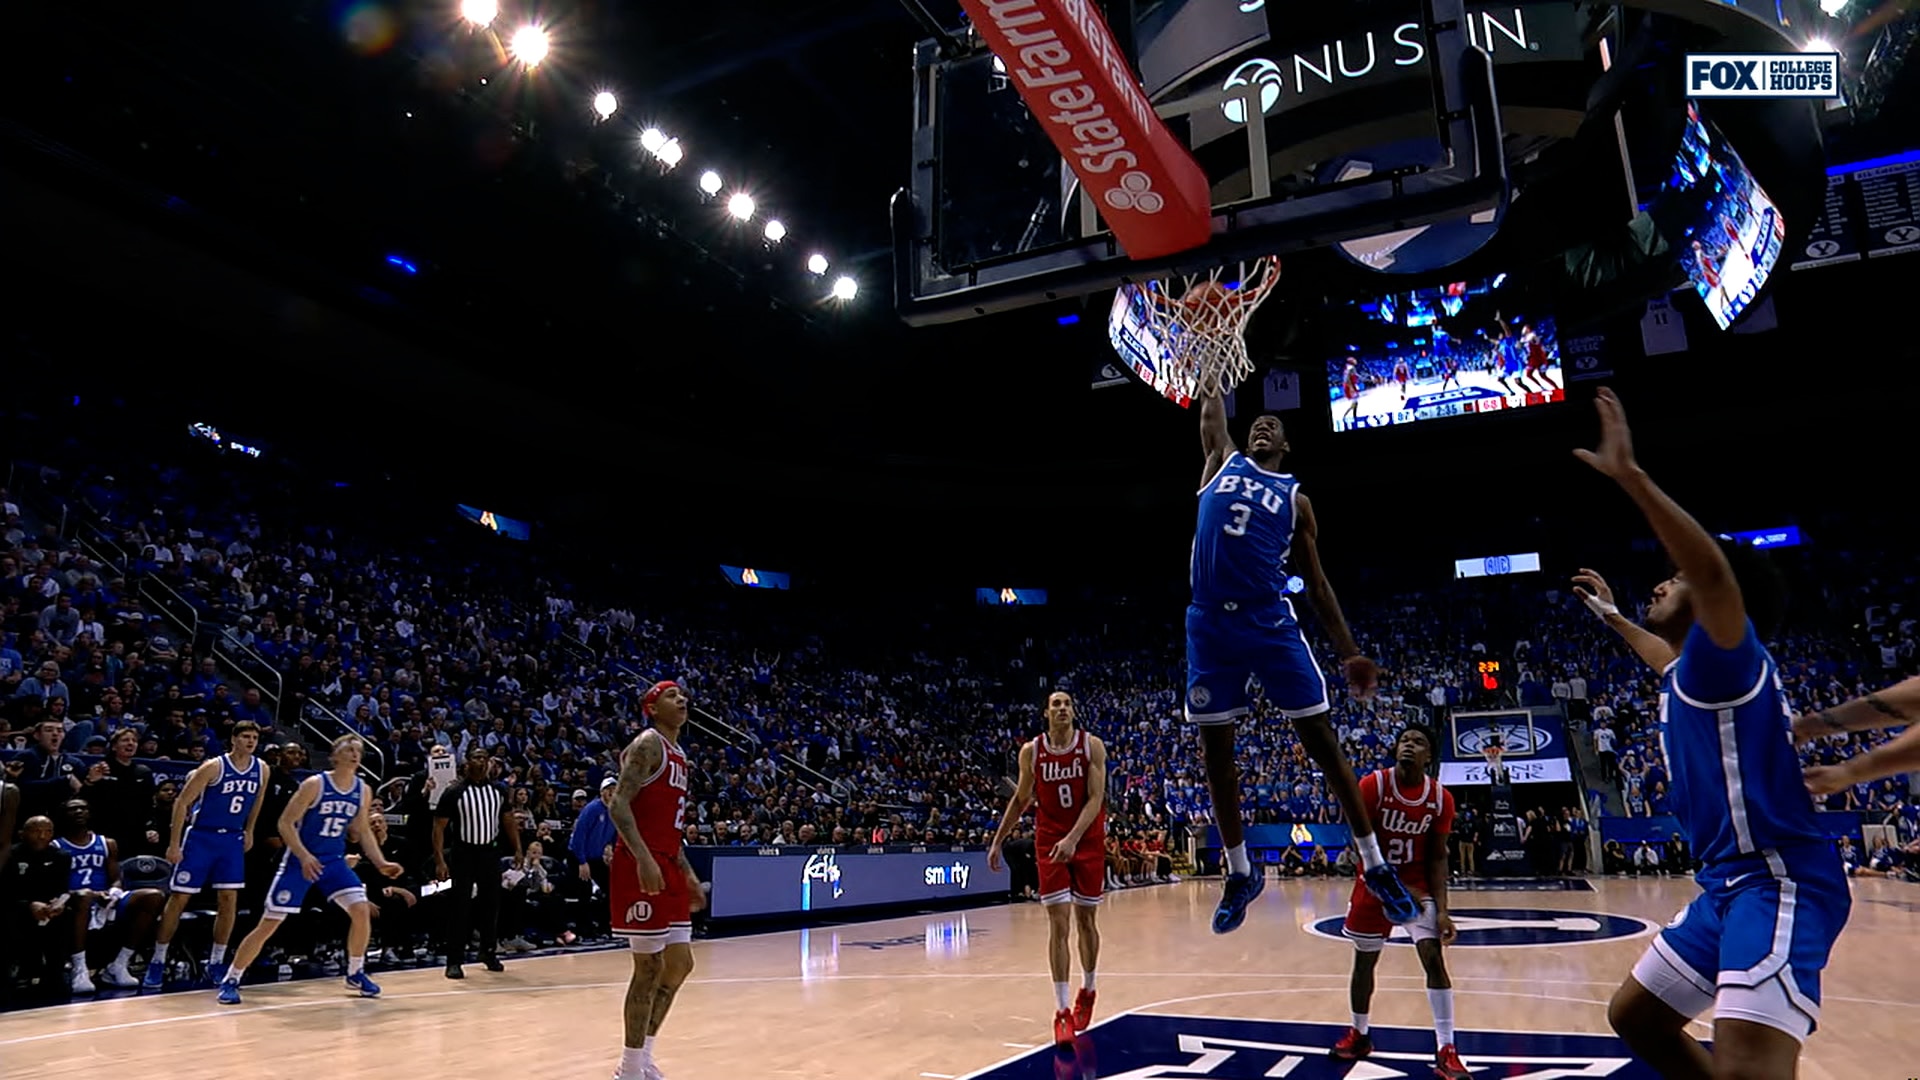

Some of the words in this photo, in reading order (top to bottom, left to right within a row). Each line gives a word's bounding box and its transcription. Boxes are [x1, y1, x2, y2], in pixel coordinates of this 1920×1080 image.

[1393, 7, 1529, 66] SIN
[1061, 0, 1151, 135] ateFarm
[1654, 313, 1668, 325] 11
[1273, 377, 1289, 392] 14
[1214, 476, 1283, 514] BYU
[1224, 503, 1251, 536] 3
[1040, 757, 1083, 782] Utah
[1464, 762, 1544, 775] ZINS
[221, 780, 259, 795] BYU
[1058, 783, 1073, 809] 8
[229, 795, 245, 815] 6
[319, 800, 359, 818] BYU
[319, 816, 348, 838] 15
[1381, 808, 1433, 835] Utah
[1387, 838, 1414, 865] 21
[77, 867, 95, 886] 7
